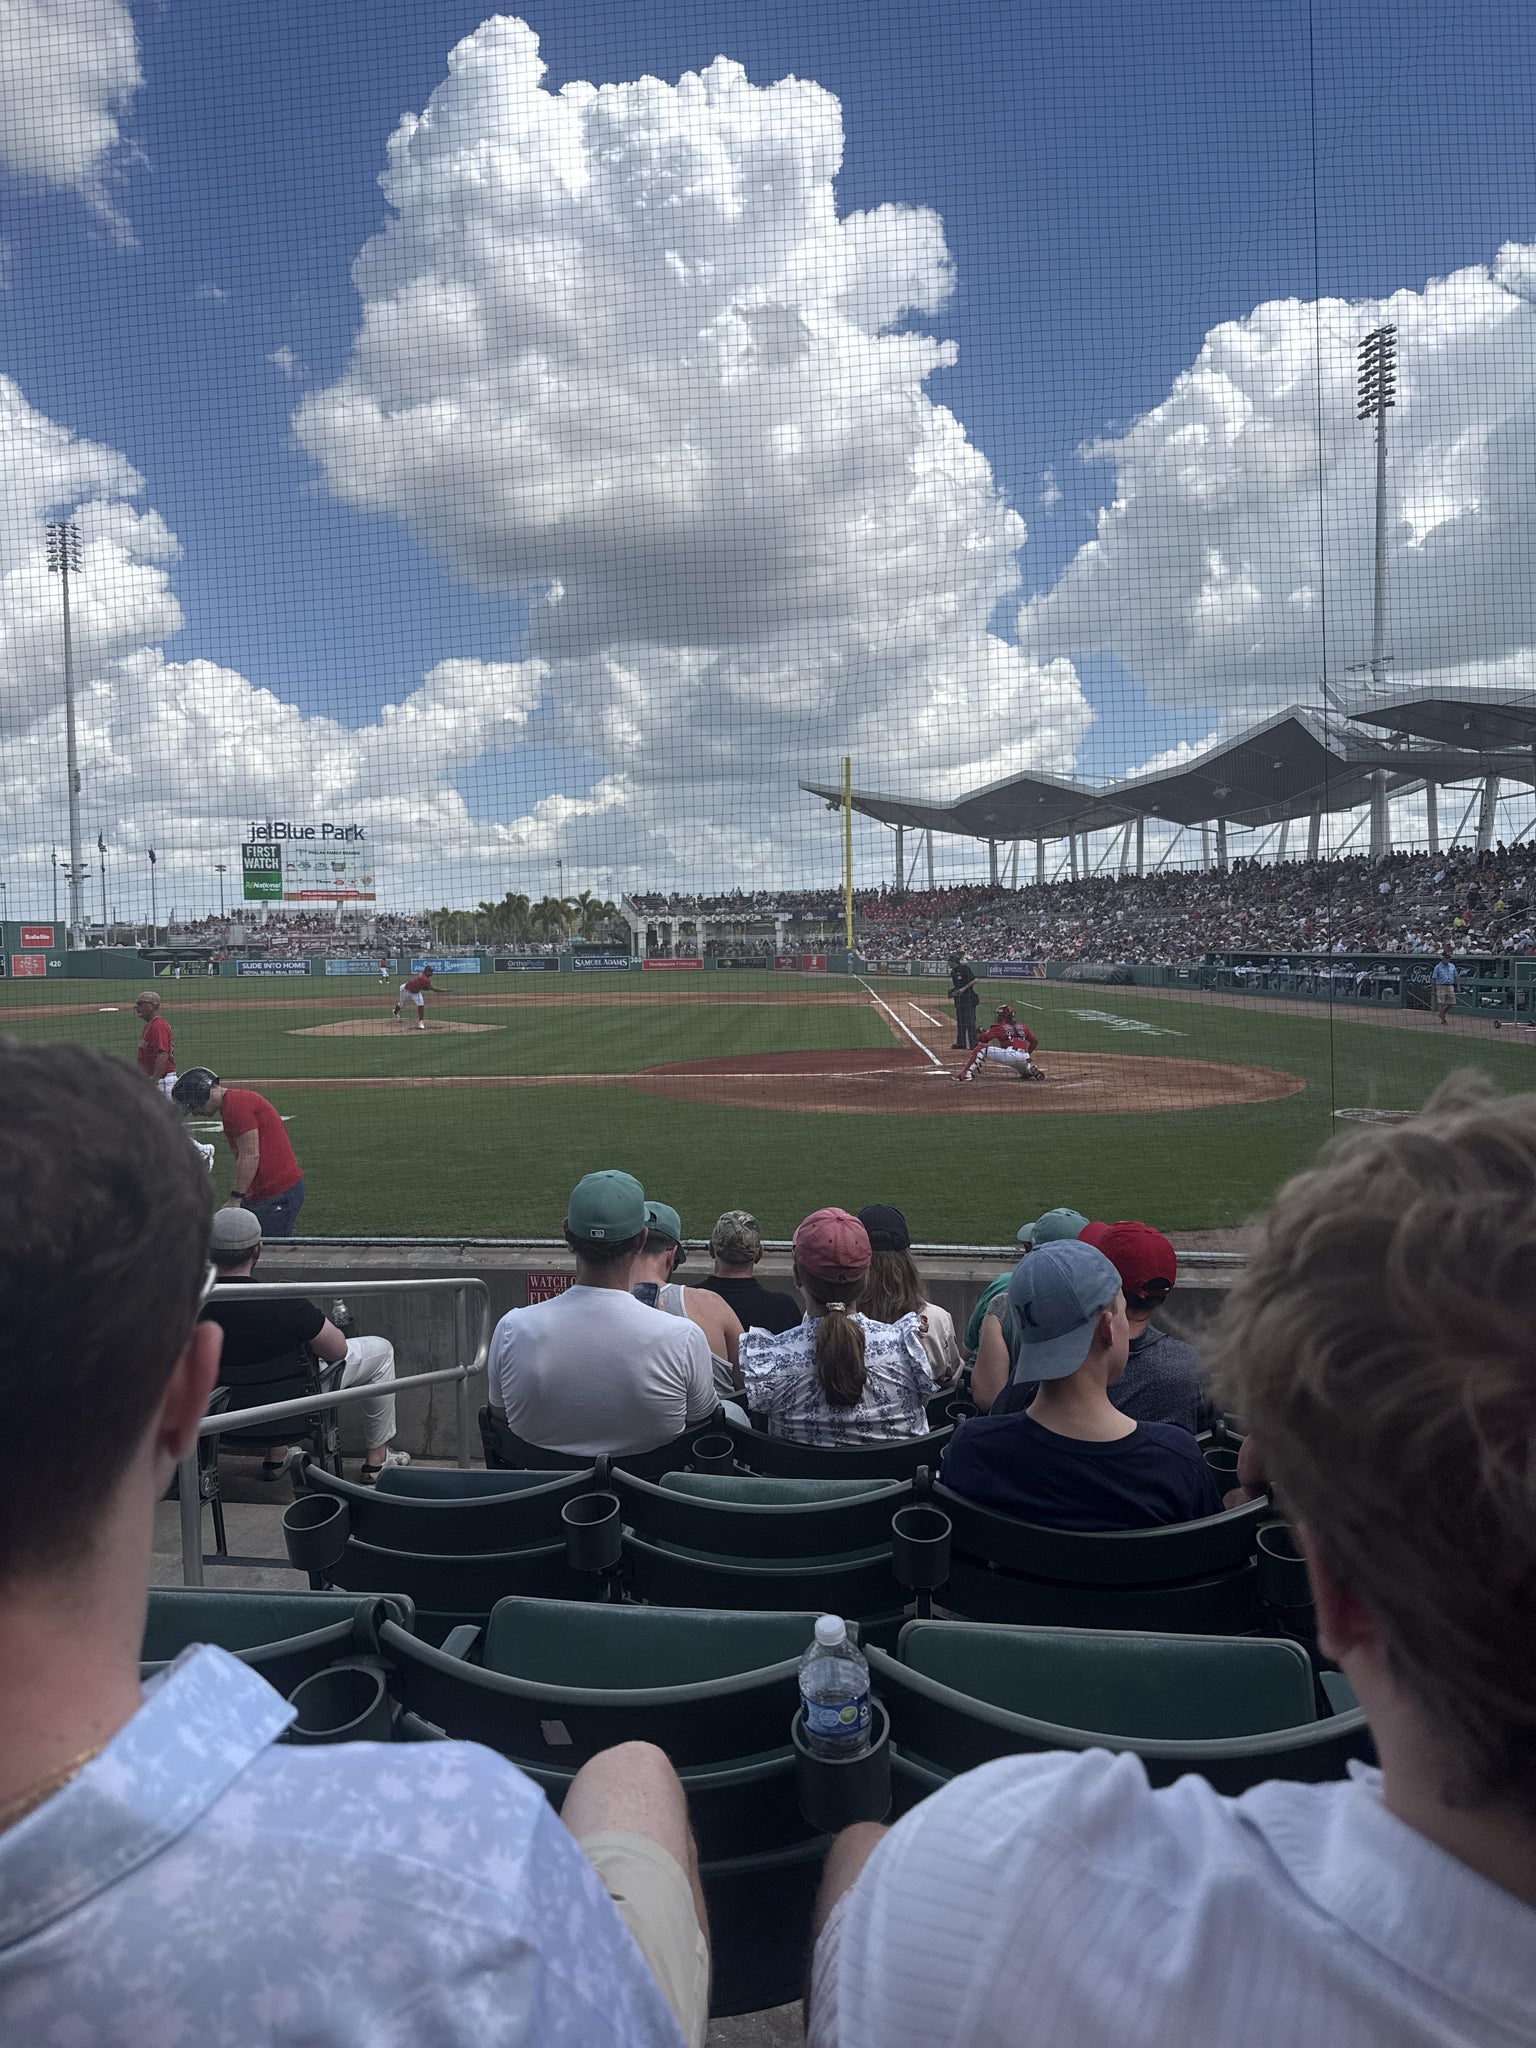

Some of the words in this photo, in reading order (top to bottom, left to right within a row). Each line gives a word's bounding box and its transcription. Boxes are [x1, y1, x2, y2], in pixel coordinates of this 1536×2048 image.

[251, 822, 315, 842] jetBlue
[322, 823, 365, 840] Park
[246, 846, 276, 857] FIRST
[244, 858, 279, 869] WATCH
[575, 959, 602, 967] SAMUEL
[530, 1275, 568, 1288] WATCH
